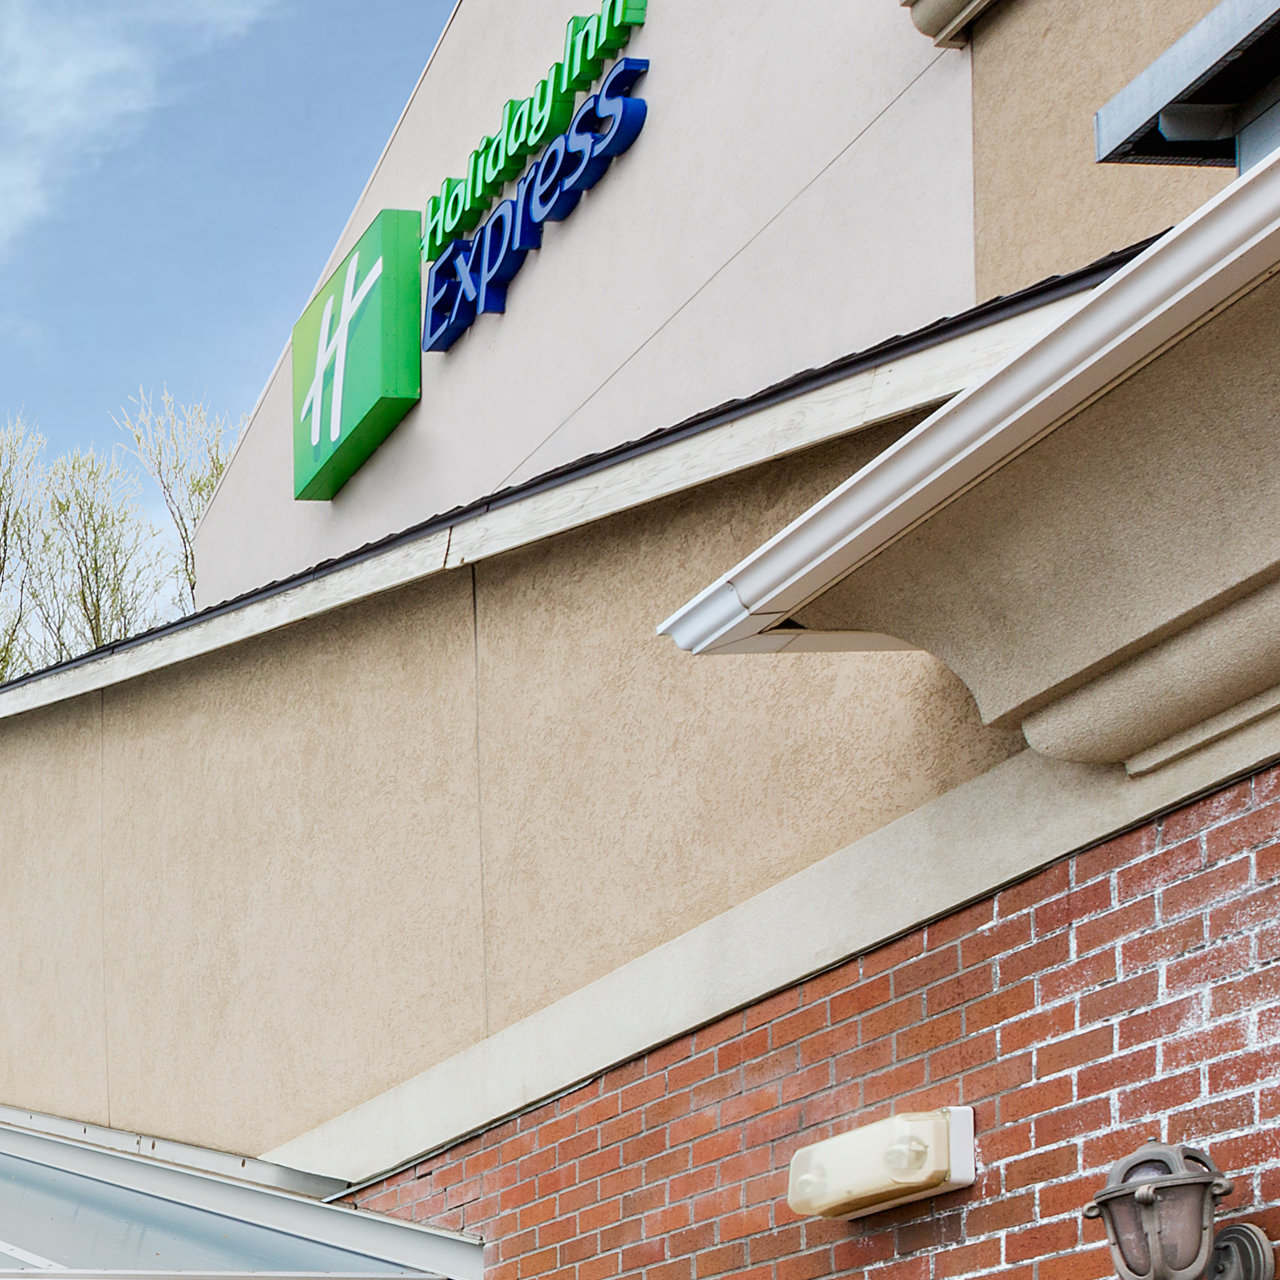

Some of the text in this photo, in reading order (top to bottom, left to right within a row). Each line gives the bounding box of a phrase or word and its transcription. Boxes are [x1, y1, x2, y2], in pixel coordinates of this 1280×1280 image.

[420, 0, 634, 262] Holiday Inn
[422, 57, 646, 352] Express
